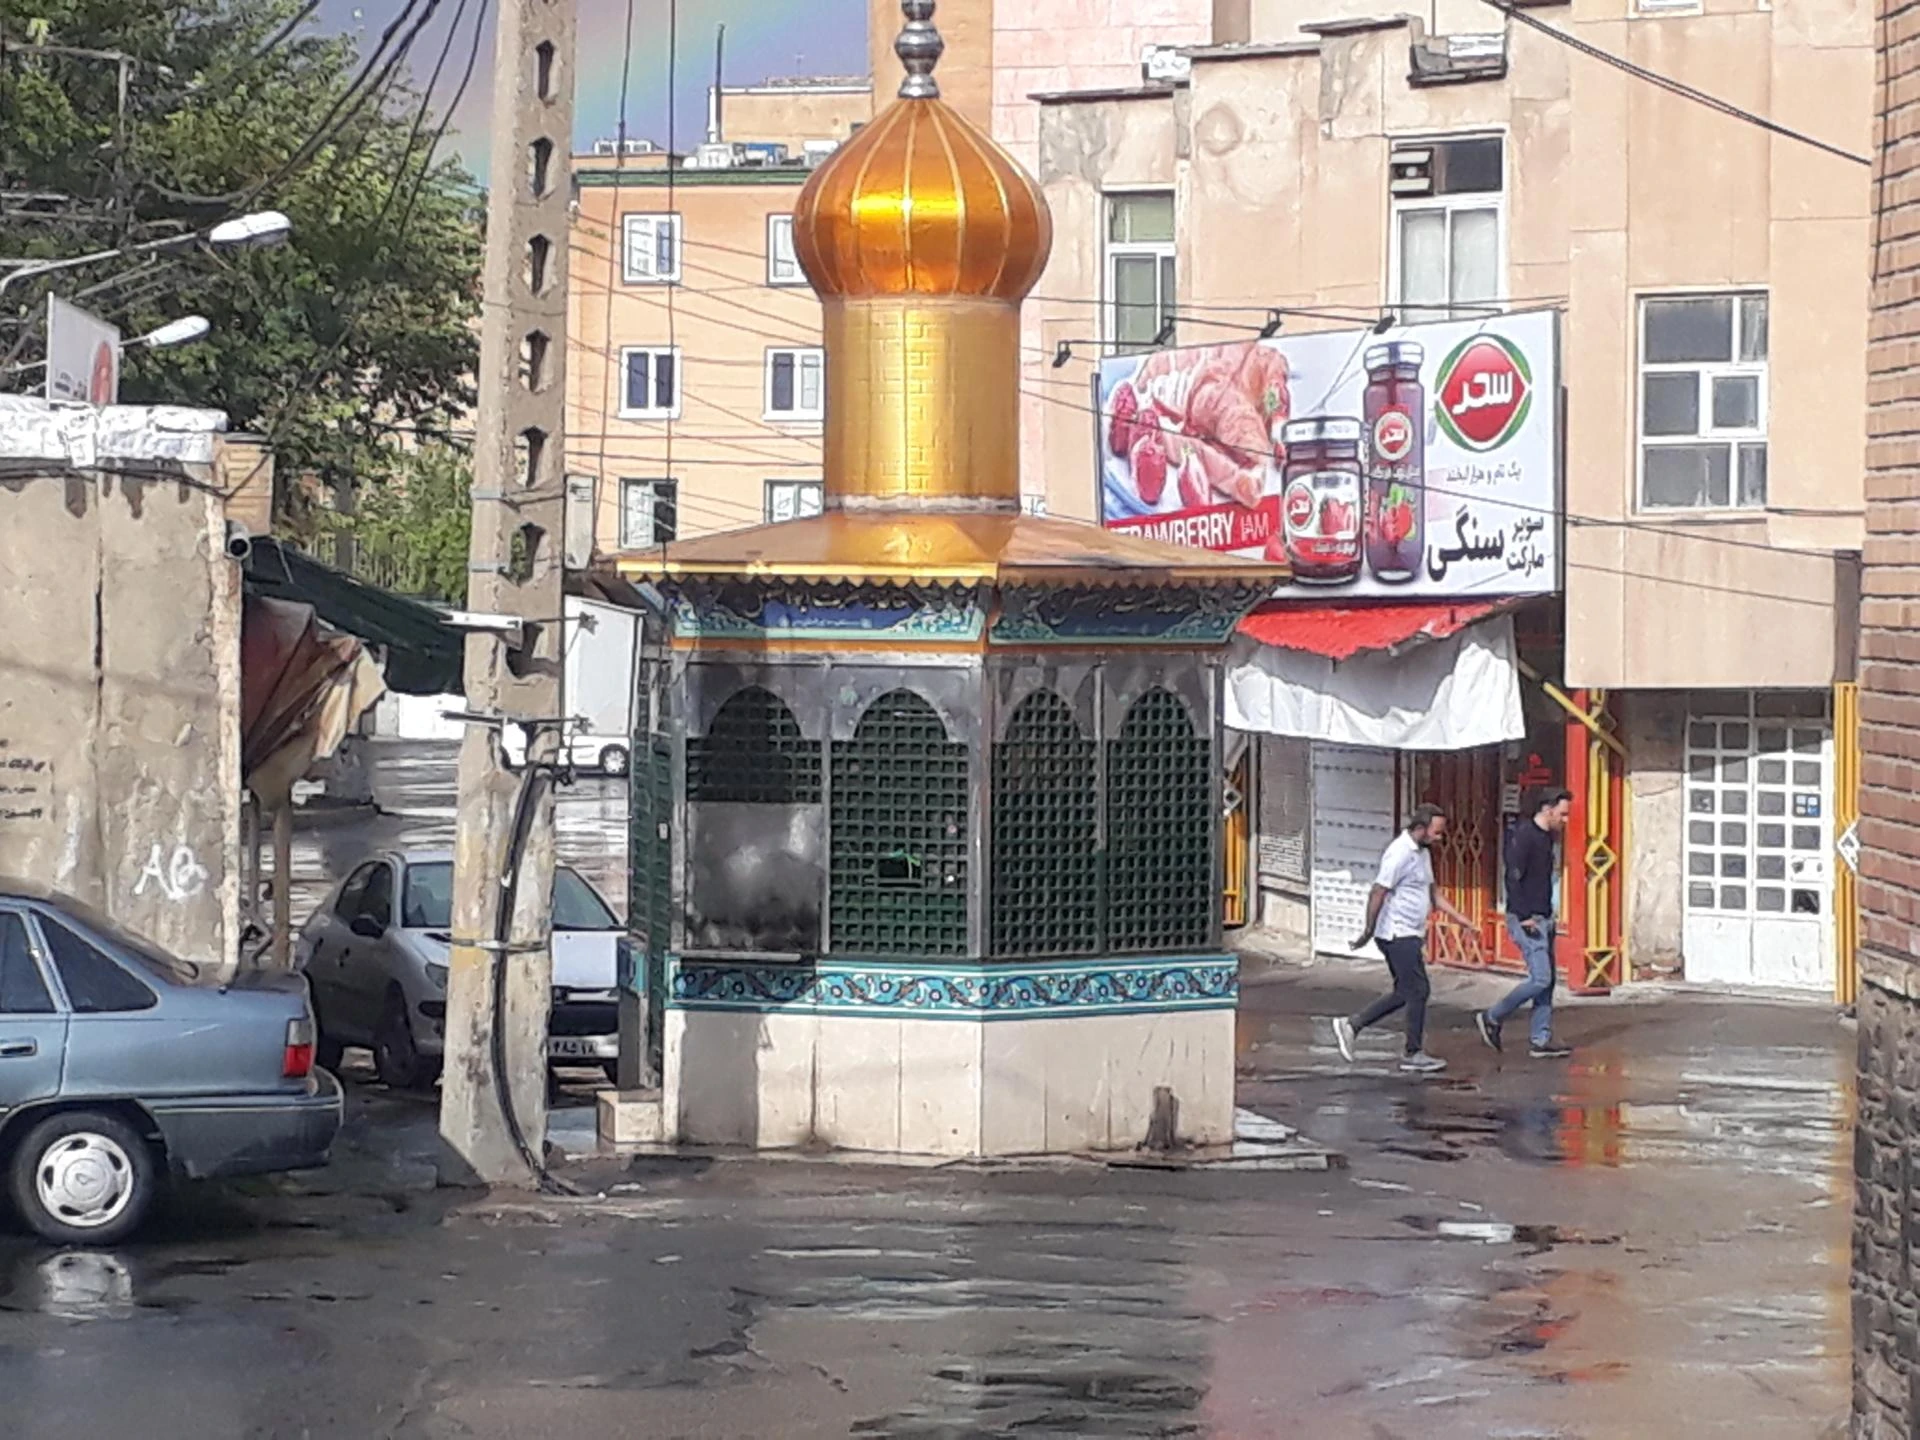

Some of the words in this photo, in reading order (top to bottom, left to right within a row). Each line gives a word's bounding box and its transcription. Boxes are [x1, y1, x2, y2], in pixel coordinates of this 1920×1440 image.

[1452, 371, 1514, 415] سحر
[1110, 511, 1235, 548] AWBERRY
[1427, 503, 1505, 582] سنگی
[1506, 543, 1545, 577] مارکت
